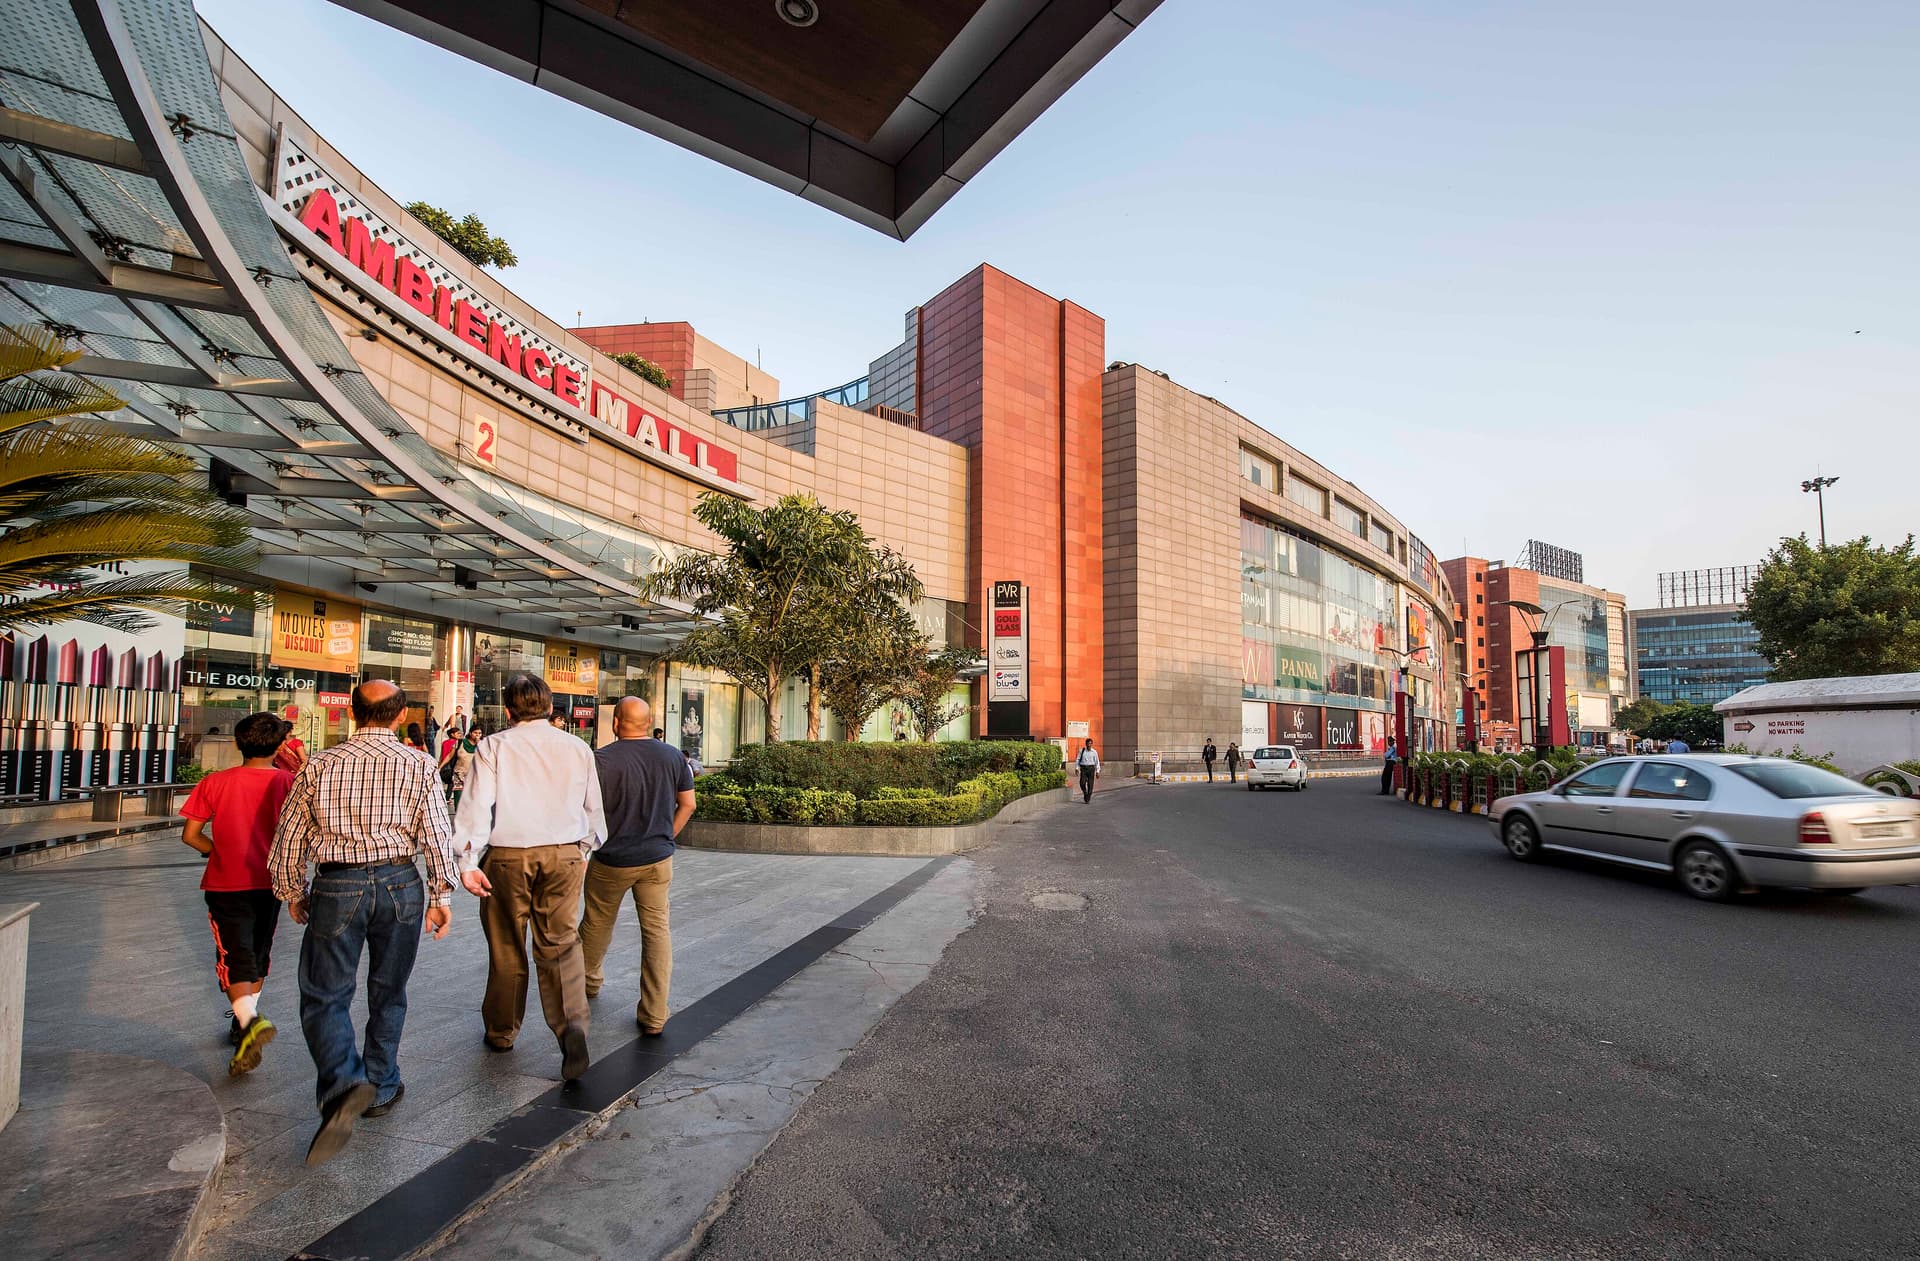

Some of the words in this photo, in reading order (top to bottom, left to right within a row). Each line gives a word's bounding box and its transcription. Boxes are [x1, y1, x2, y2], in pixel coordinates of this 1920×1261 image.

[299, 188, 582, 409] AMBIENCE
[597, 388, 718, 476] MALL
[478, 422, 495, 464] 2
[997, 584, 1018, 598] PVR
[280, 611, 325, 639] MOVIES
[995, 623, 1021, 632] CLASS
[996, 615, 1019, 623] GOLD
[285, 634, 324, 655] DISCOUNT
[549, 655, 577, 673] MOVIES
[1281, 658, 1319, 680] PANNA
[187, 671, 220, 685] THE
[226, 673, 273, 688] BODY
[275, 677, 315, 690] SHOP
[321, 695, 331, 704] NO
[331, 696, 350, 705] ENTRY
[1327, 720, 1353, 745] fcuk
